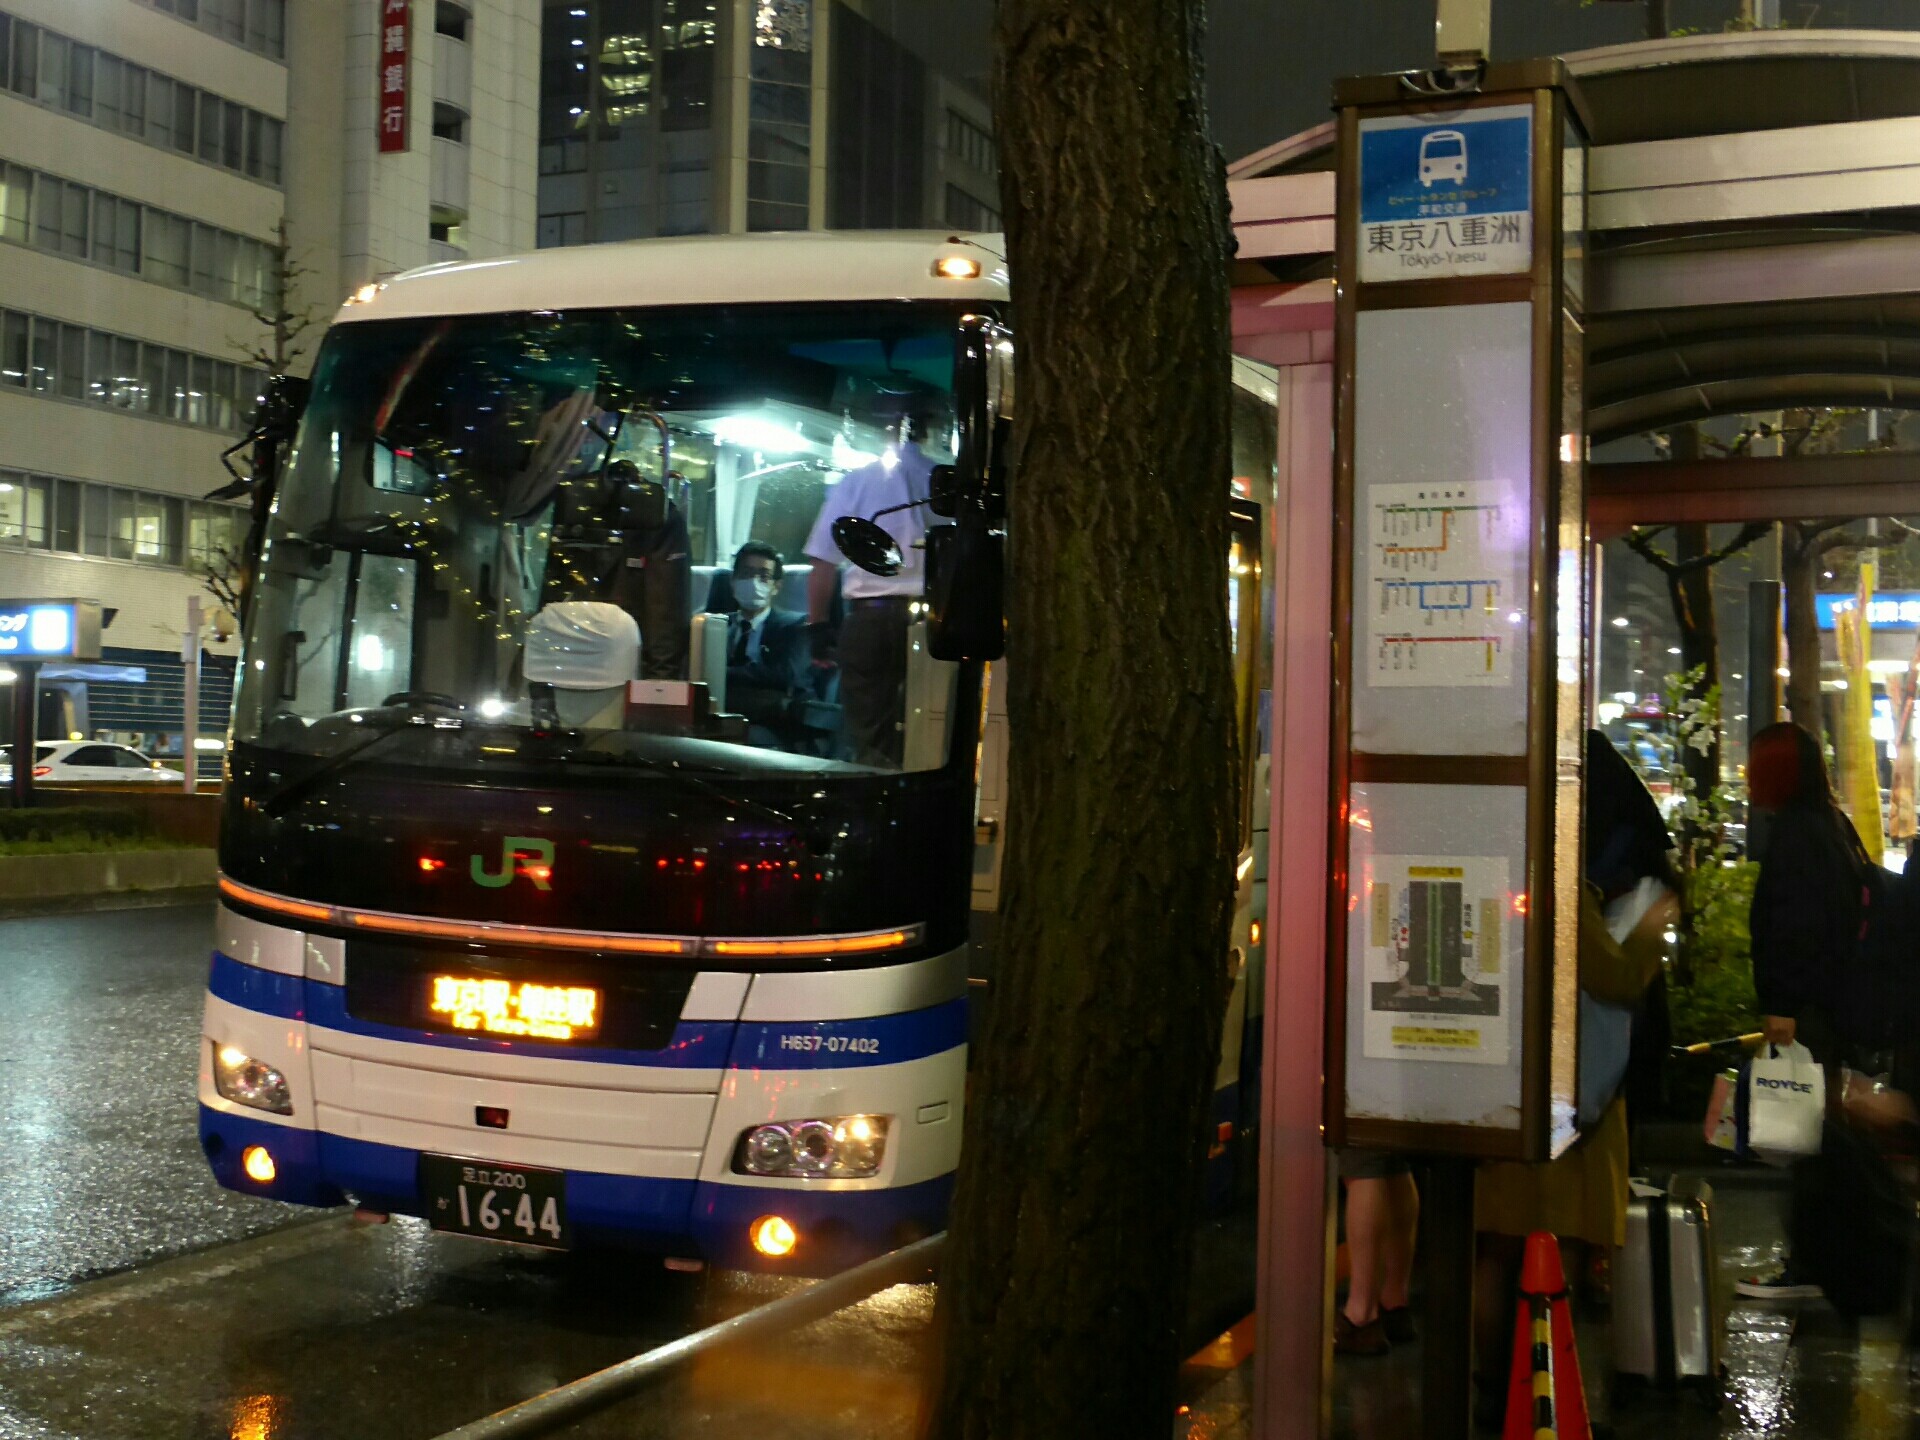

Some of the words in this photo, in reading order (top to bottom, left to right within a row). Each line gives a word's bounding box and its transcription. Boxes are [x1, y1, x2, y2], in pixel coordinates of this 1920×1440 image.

[1367, 215, 1520, 253] 東京八重洲
[470, 836, 555, 891] JR
[781, 1035, 880, 1054] H657-07402
[457, 1184, 562, 1240] 16-44
